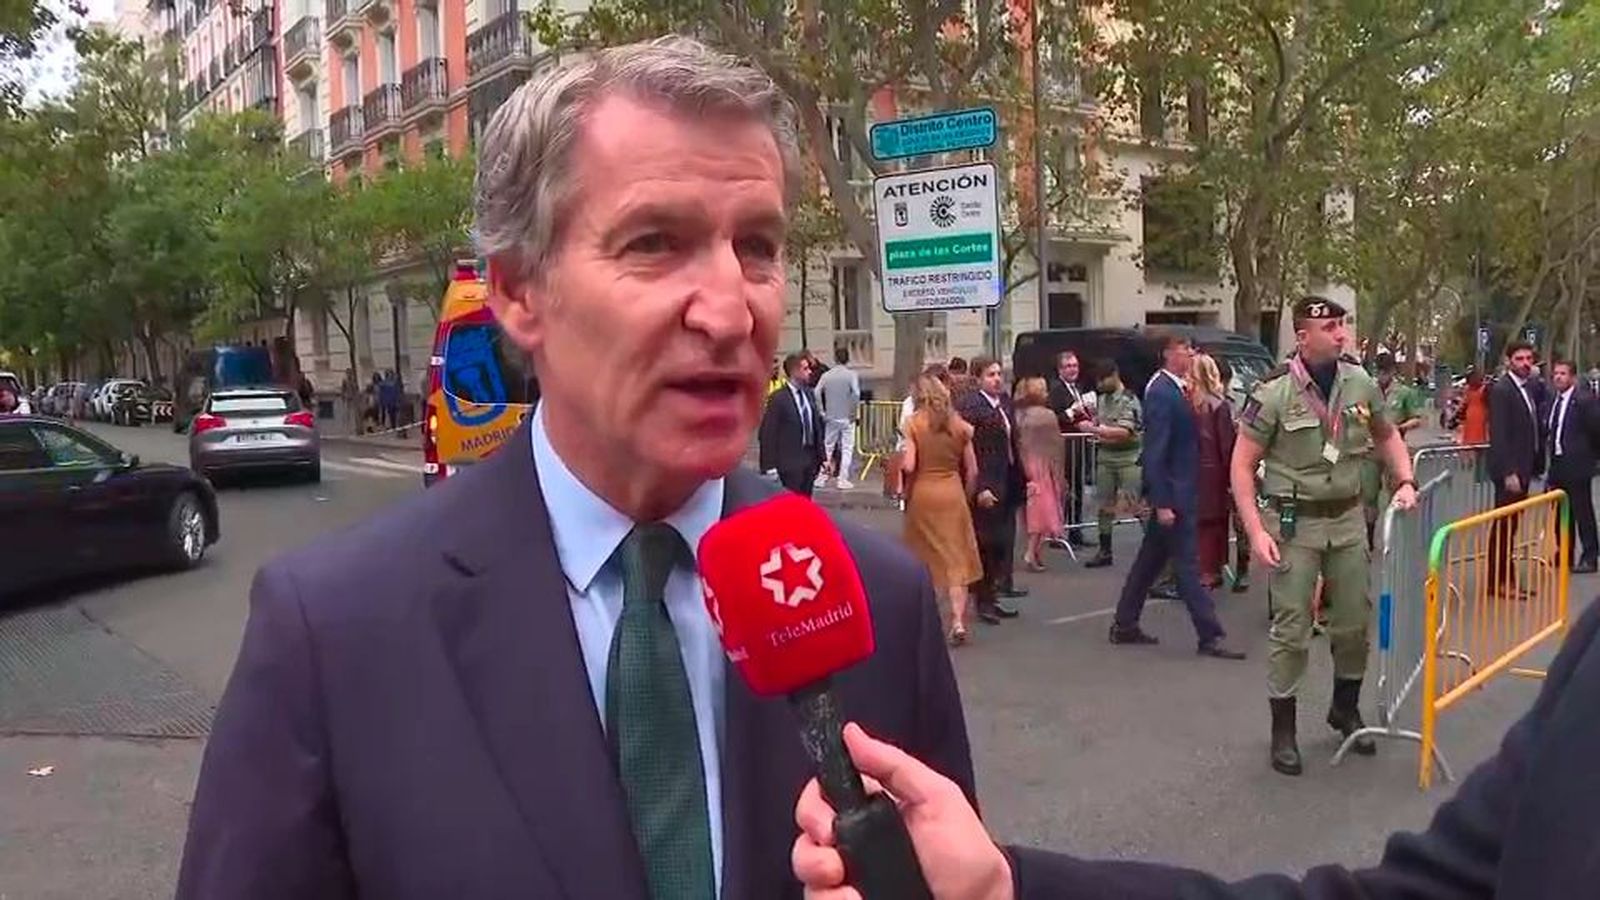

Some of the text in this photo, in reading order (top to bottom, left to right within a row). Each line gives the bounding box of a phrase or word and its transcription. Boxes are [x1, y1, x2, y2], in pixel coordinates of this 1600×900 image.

[901, 114, 992, 137] Distrito Centro
[883, 173, 988, 199] ATENCIÓN
[889, 249, 916, 263] plaza
[919, 247, 931, 257] de
[952, 242, 988, 255] Cortes
[928, 270, 993, 284] RESTRINGIDO
[768, 601, 854, 647] TeleMadrid
